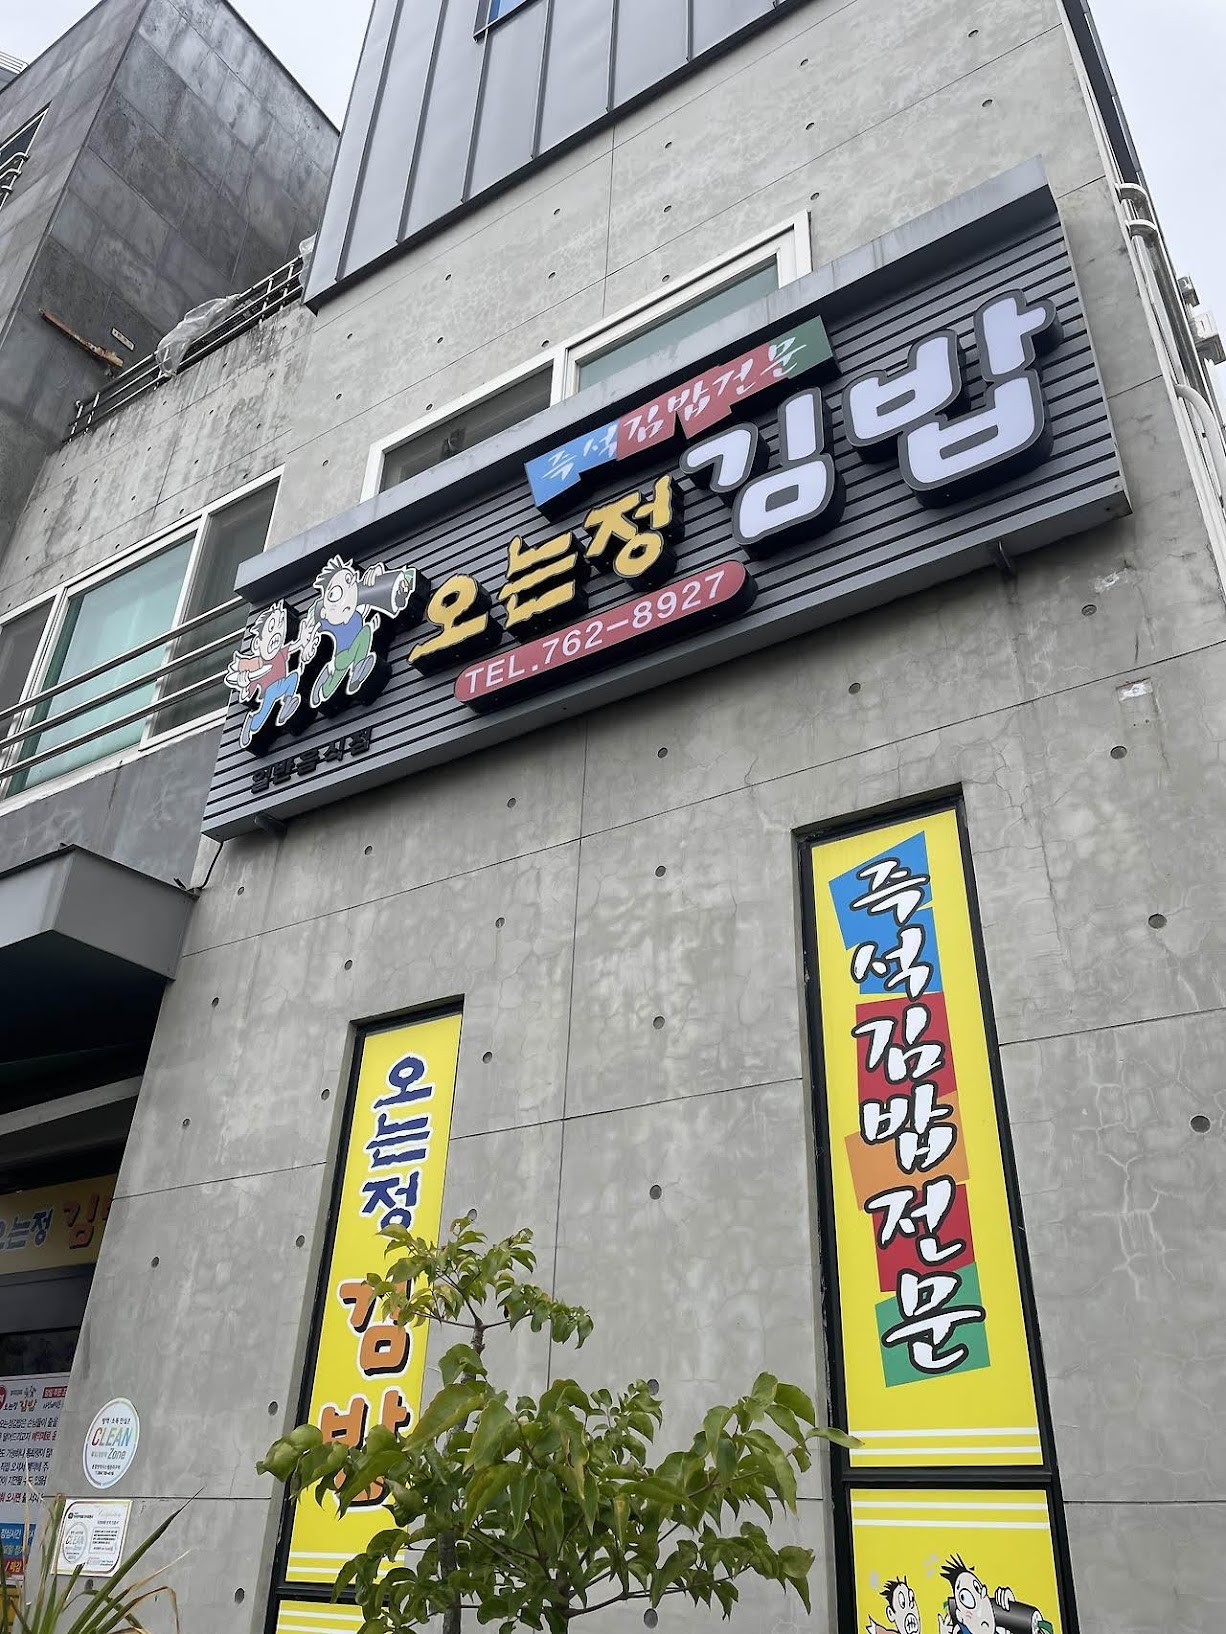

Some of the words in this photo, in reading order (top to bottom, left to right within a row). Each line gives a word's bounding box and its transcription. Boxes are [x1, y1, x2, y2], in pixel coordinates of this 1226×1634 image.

[408, 475, 673, 664] 오는정
[680, 290, 1053, 546] 김밥
[251, 727, 373, 794] 일반음식점
[361, 1055, 433, 1232] 오는정
[0, 1206, 54, 1251] 는정
[62, 1192, 110, 1251] 김
[91, 1426, 134, 1447] CLEAN
[107, 1447, 127, 1460] Zone
